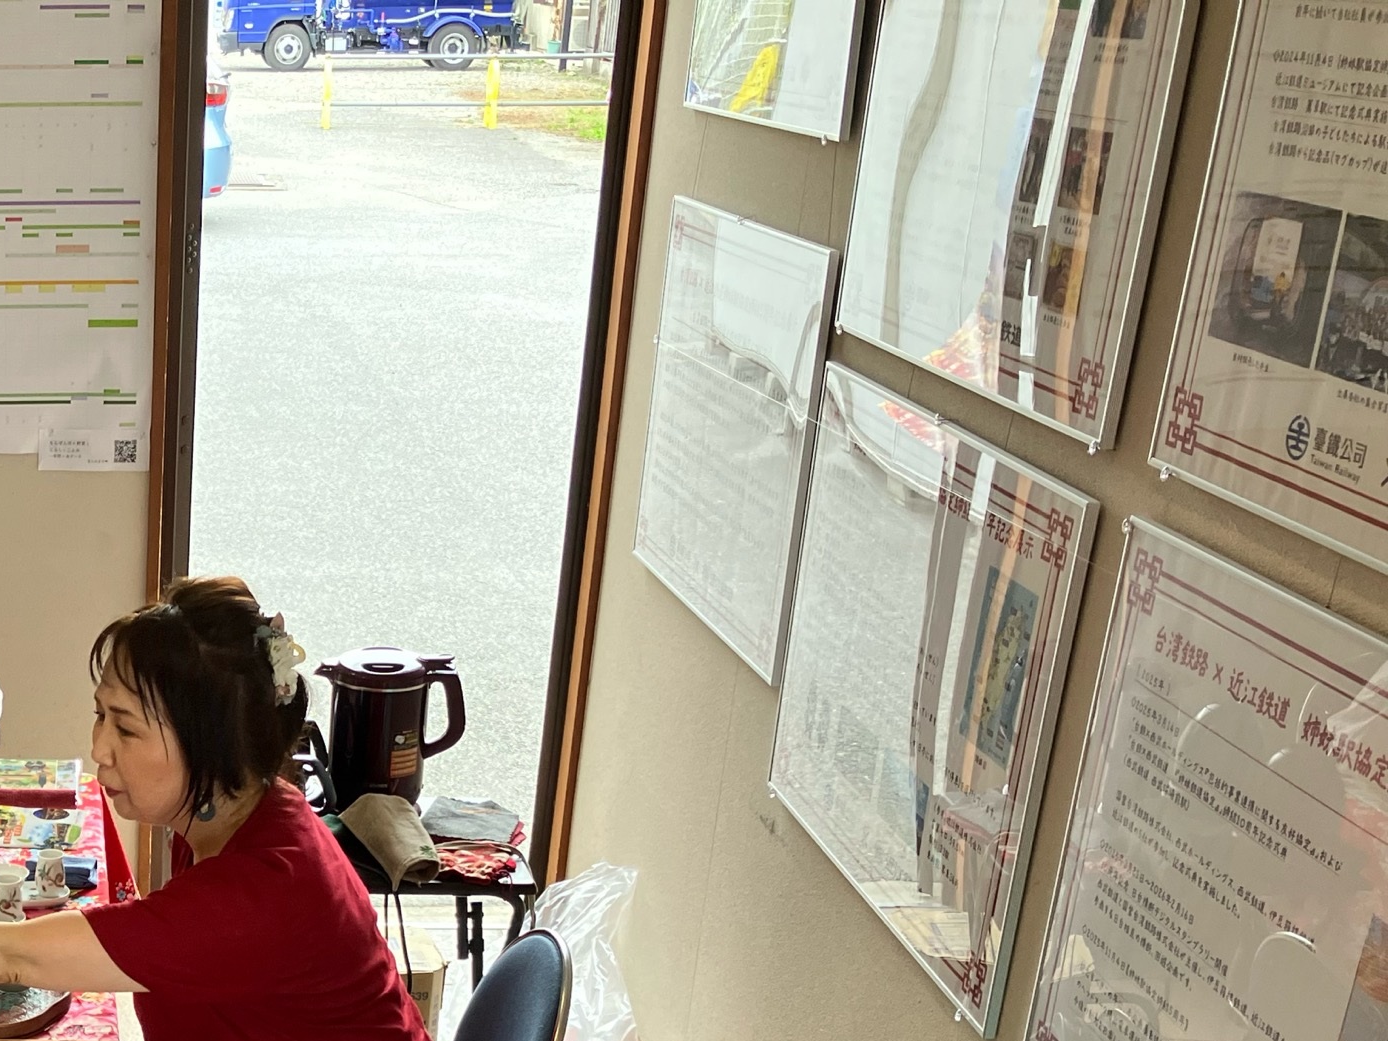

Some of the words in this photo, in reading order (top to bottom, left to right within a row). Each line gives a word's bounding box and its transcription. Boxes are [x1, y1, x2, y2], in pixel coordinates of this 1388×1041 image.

[1311, 454, 1333, 472] Taiwan
[1226, 665, 1291, 730] 近江鉄道
